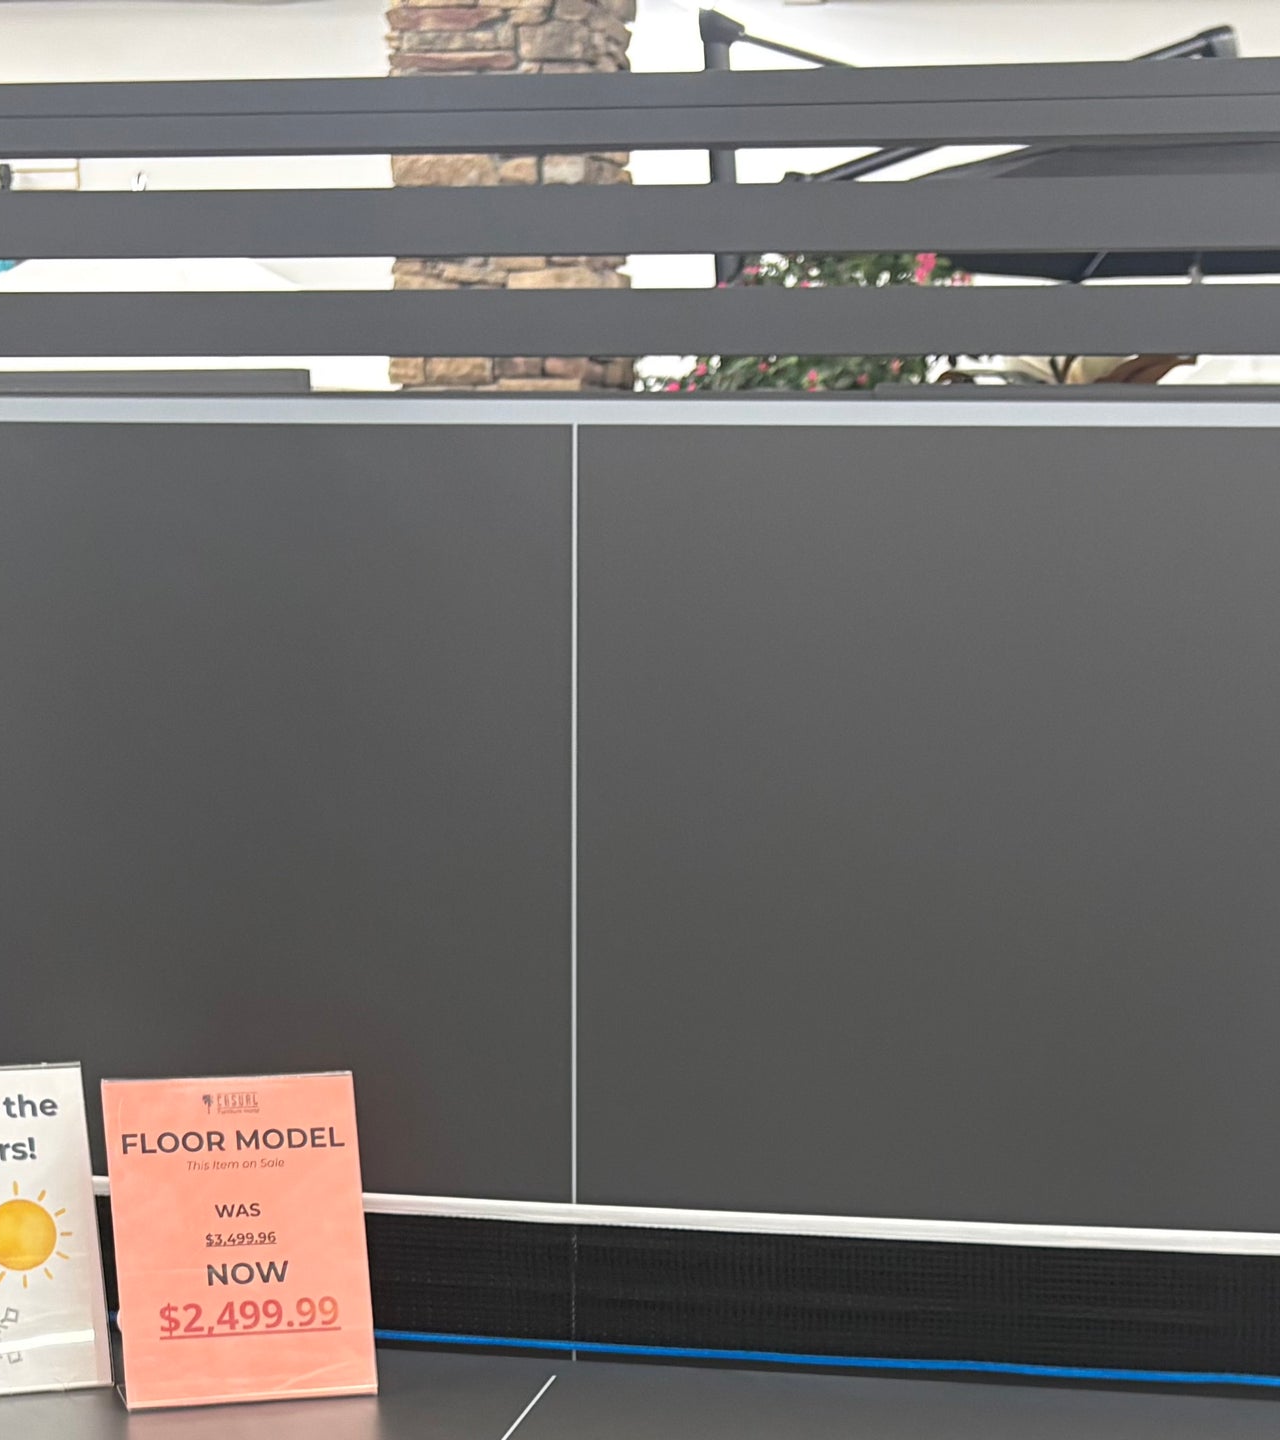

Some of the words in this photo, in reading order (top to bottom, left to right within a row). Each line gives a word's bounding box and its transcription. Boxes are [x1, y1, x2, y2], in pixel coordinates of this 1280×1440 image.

[3, 1094, 59, 1118] the
[217, 1092, 259, 1107] CASUAL
[122, 1130, 225, 1155] FLOOR
[236, 1126, 345, 1151] MODEL
[186, 1160, 210, 1171] This
[212, 1158, 239, 1170] Item
[242, 1159, 258, 1169] on
[261, 1158, 285, 1168] Sale
[215, 1202, 261, 1218] WAS
[205, 1231, 277, 1247] $3,499.96
[206, 1260, 289, 1286] NOW
[159, 1296, 341, 1339] $2,499.99
